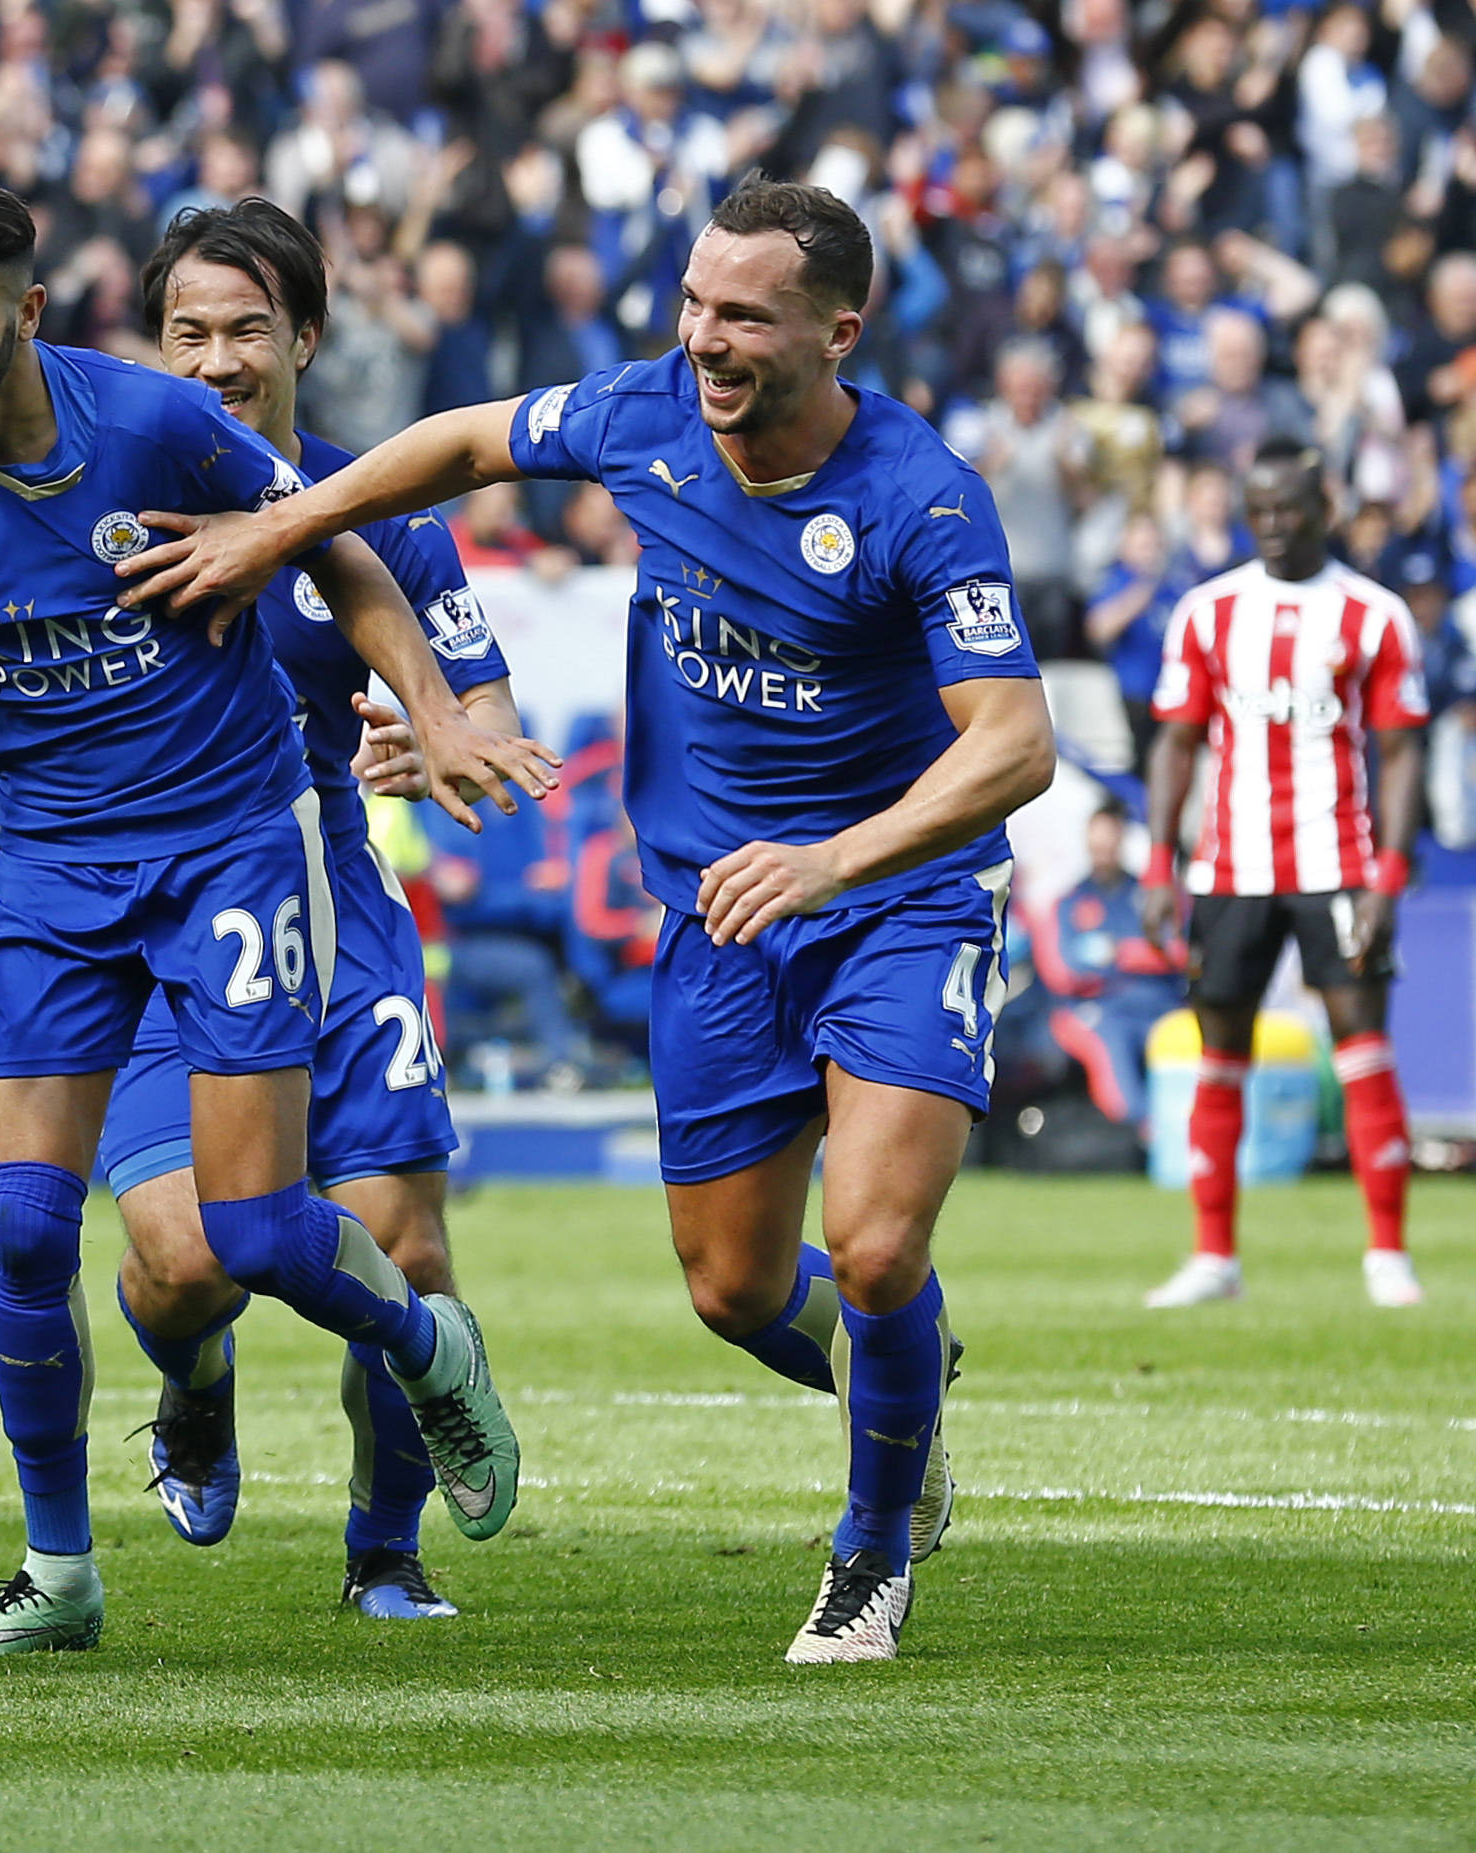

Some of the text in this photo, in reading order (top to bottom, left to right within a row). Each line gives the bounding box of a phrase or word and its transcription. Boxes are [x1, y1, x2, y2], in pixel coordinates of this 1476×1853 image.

[663, 632, 823, 712] POWER
[964, 625, 1008, 637] BARCLAYS
[212, 895, 305, 1008] 26
[942, 942, 982, 1039] 4
